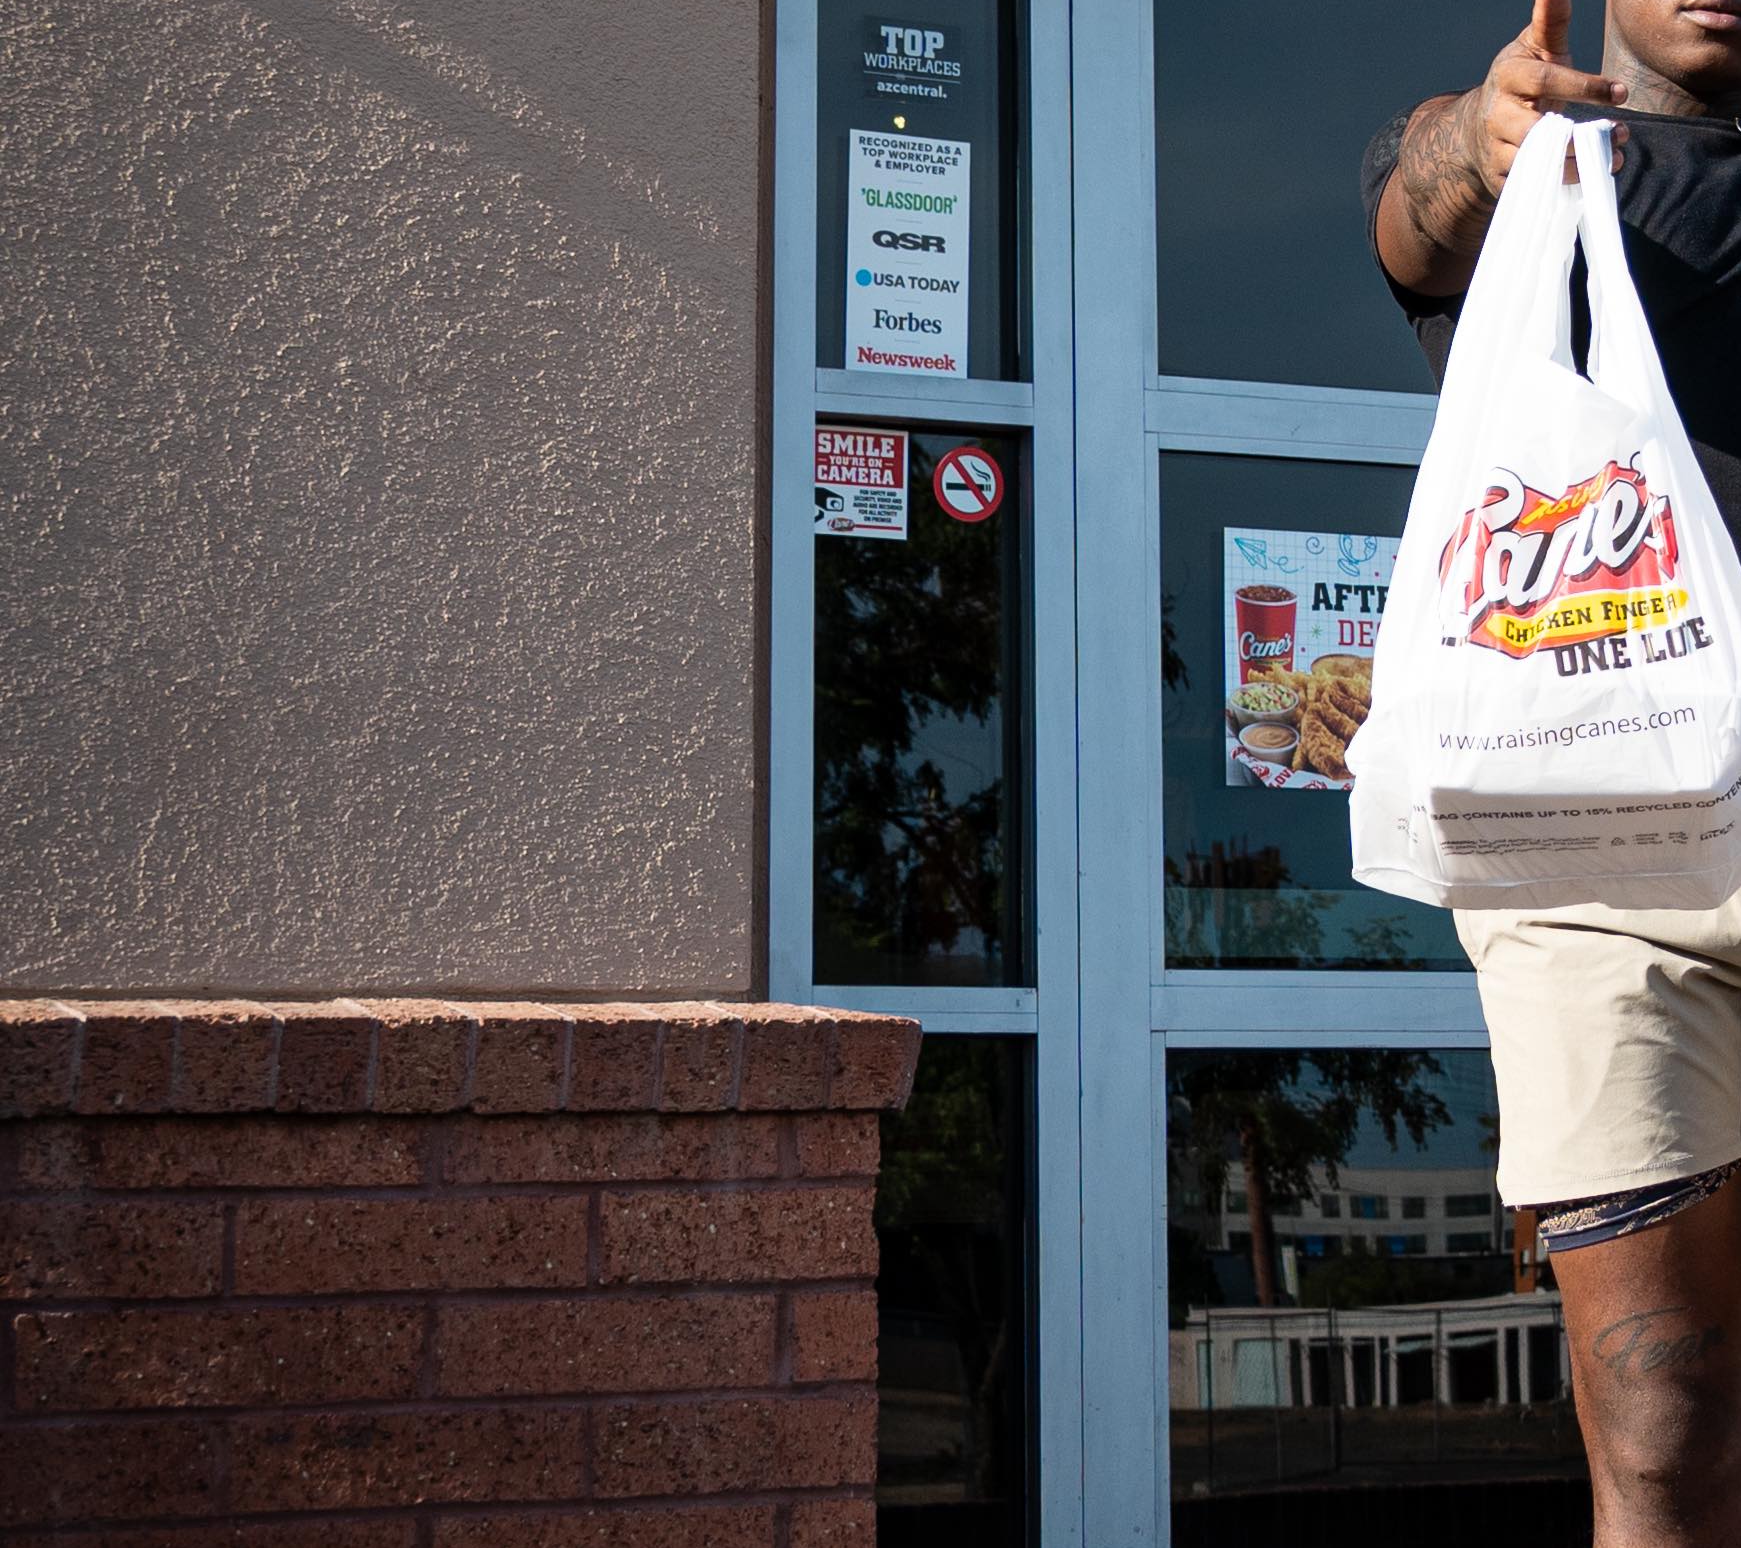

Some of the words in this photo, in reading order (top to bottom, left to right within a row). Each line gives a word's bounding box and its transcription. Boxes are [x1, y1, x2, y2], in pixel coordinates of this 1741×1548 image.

[881, 25, 944, 58] TOP
[864, 51, 961, 77] WORKPLACES
[877, 81, 948, 99] azcentral.
[858, 135, 933, 153] RECOGNIZED
[936, 145, 950, 154] AS
[954, 147, 962, 156] A
[862, 147, 885, 157] TOP
[889, 150, 958, 167] WORKPLACE
[874, 159, 882, 169] &
[886, 161, 946, 176] EMPLOYER
[872, 230, 946, 254] QSR
[874, 272, 905, 289] USA
[908, 275, 960, 293] TODAY
[873, 308, 942, 335] Forbes
[857, 346, 956, 371] Newsweek
[817, 432, 895, 458] SMILE
[829, 455, 865, 467] YOU'RE
[868, 458, 883, 468] ON
[817, 464, 895, 485] CAMERA
[1554, 637, 1632, 677] ONE
[1641, 616, 1714, 664] LOE
[1462, 810, 1534, 822] CONTAINS
[1537, 809, 1557, 818] UP
[1560, 809, 1581, 817] TO
[1616, 801, 1692, 814] RECYCLED
